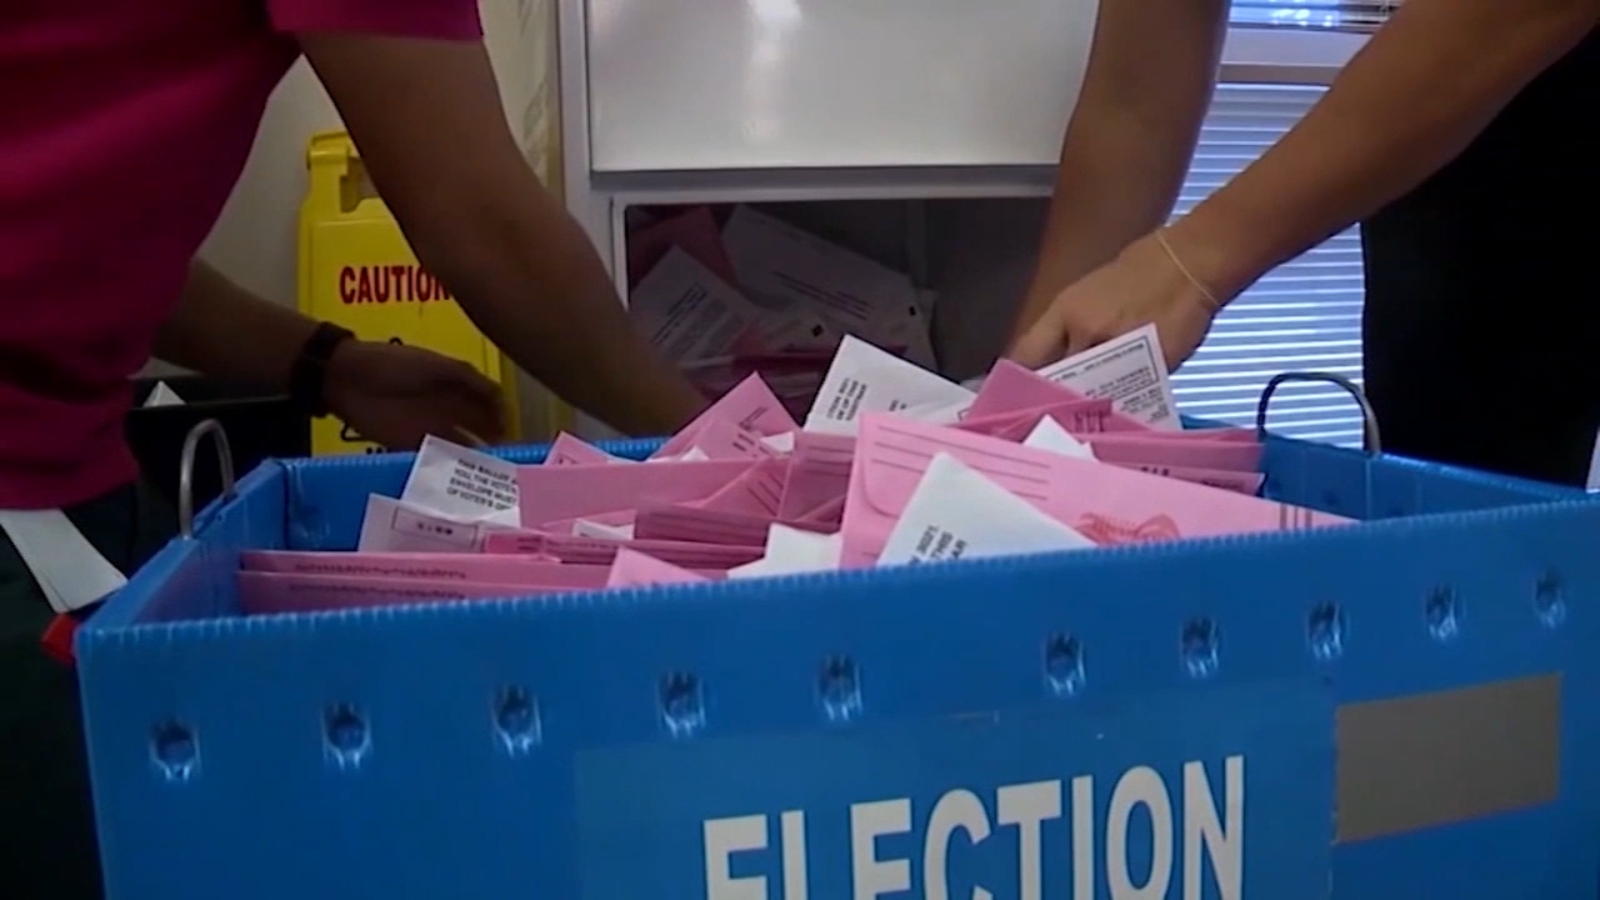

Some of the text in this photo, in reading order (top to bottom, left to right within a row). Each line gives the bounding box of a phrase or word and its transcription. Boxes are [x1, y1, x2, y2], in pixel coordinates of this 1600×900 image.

[340, 265, 450, 304] CAUTION
[479, 466, 509, 481] BALLOT
[450, 477, 493, 496] ENVELOPE
